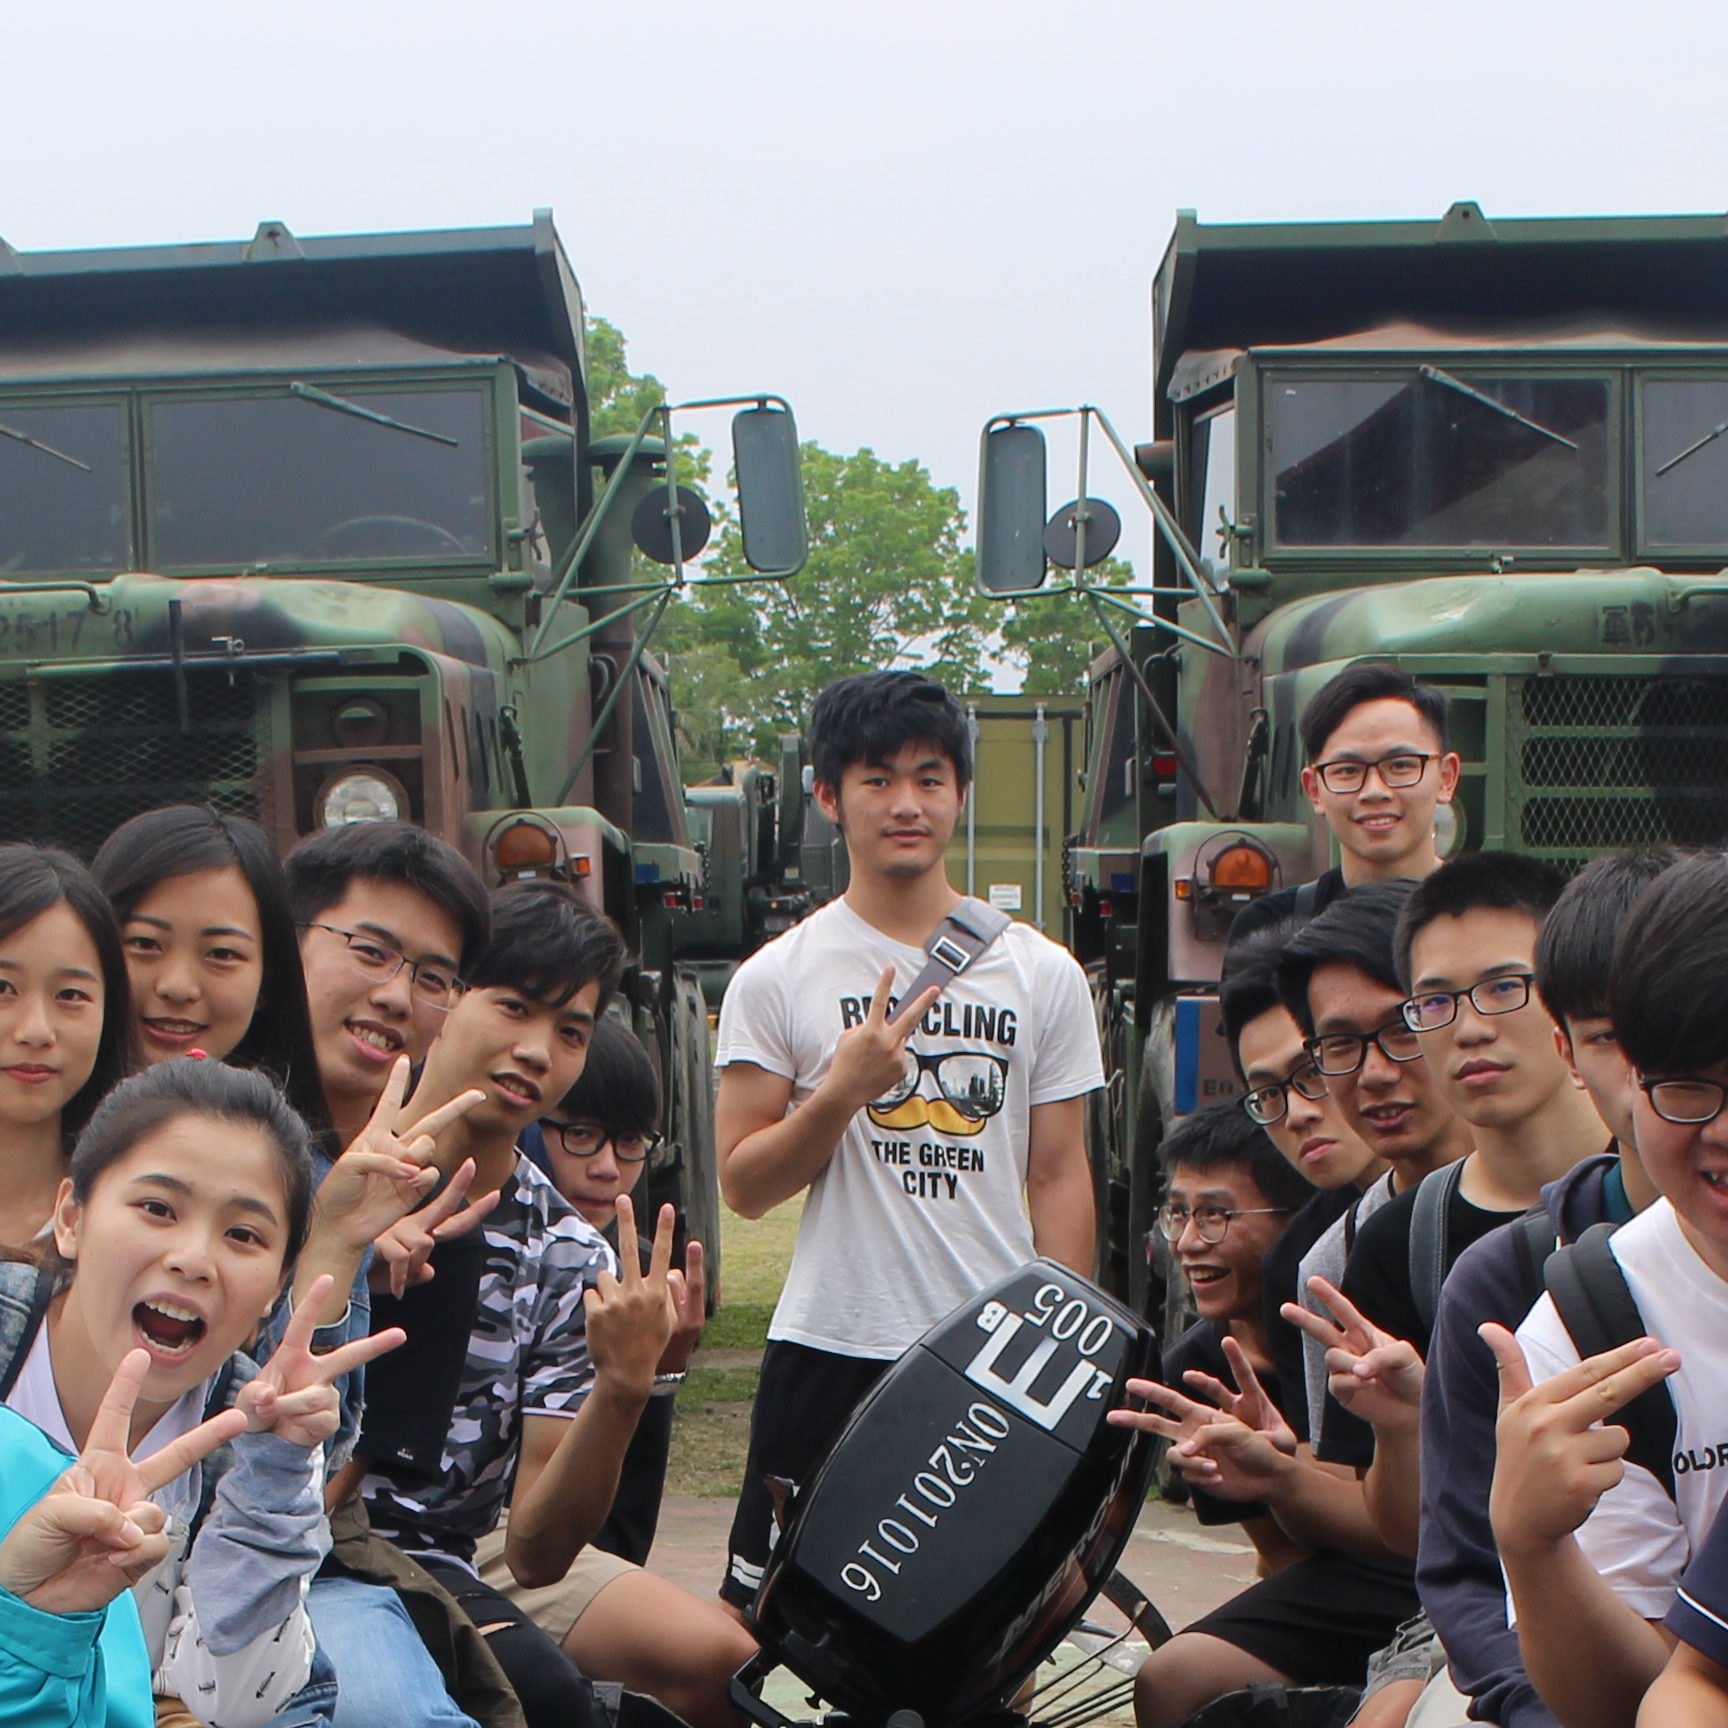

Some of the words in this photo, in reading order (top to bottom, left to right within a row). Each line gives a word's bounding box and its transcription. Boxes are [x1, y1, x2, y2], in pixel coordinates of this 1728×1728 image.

[839, 996, 1018, 1046] RCLING
[871, 1140, 911, 1165] THE
[919, 1143, 984, 1172] GREEN
[903, 1171, 958, 1199] CITY
[1024, 1283, 1114, 1356] 005
